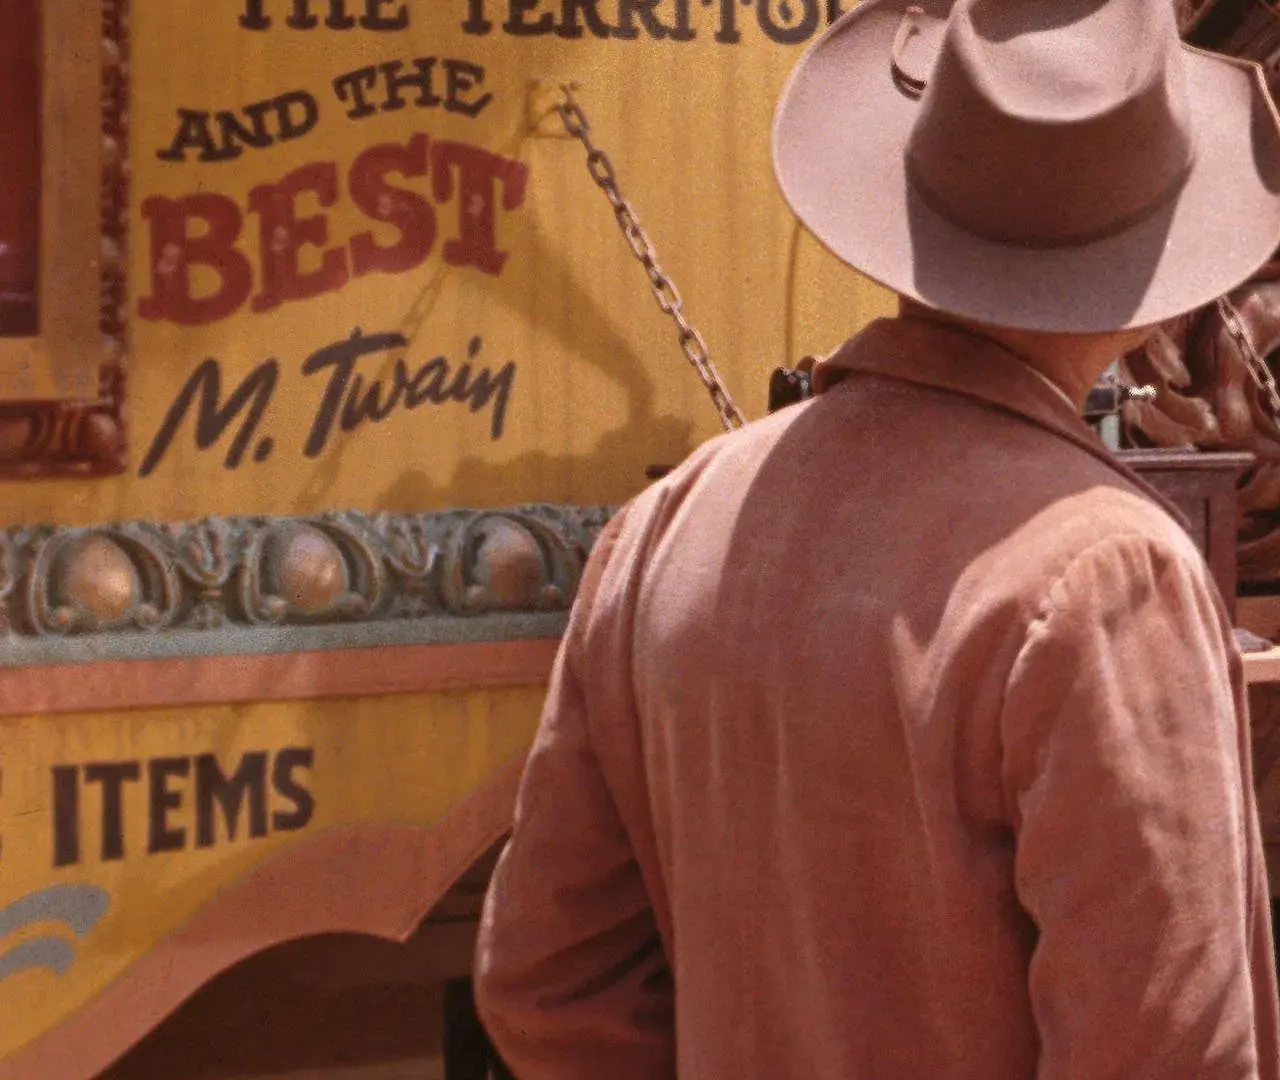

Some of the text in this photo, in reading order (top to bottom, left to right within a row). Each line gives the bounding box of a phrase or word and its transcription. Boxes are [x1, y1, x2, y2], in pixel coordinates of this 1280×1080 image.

[157, 56, 493, 162] AND THE
[136, 131, 530, 327] BEST
[137, 325, 518, 478] M. Twain
[50, 746, 315, 868] ITEMS
